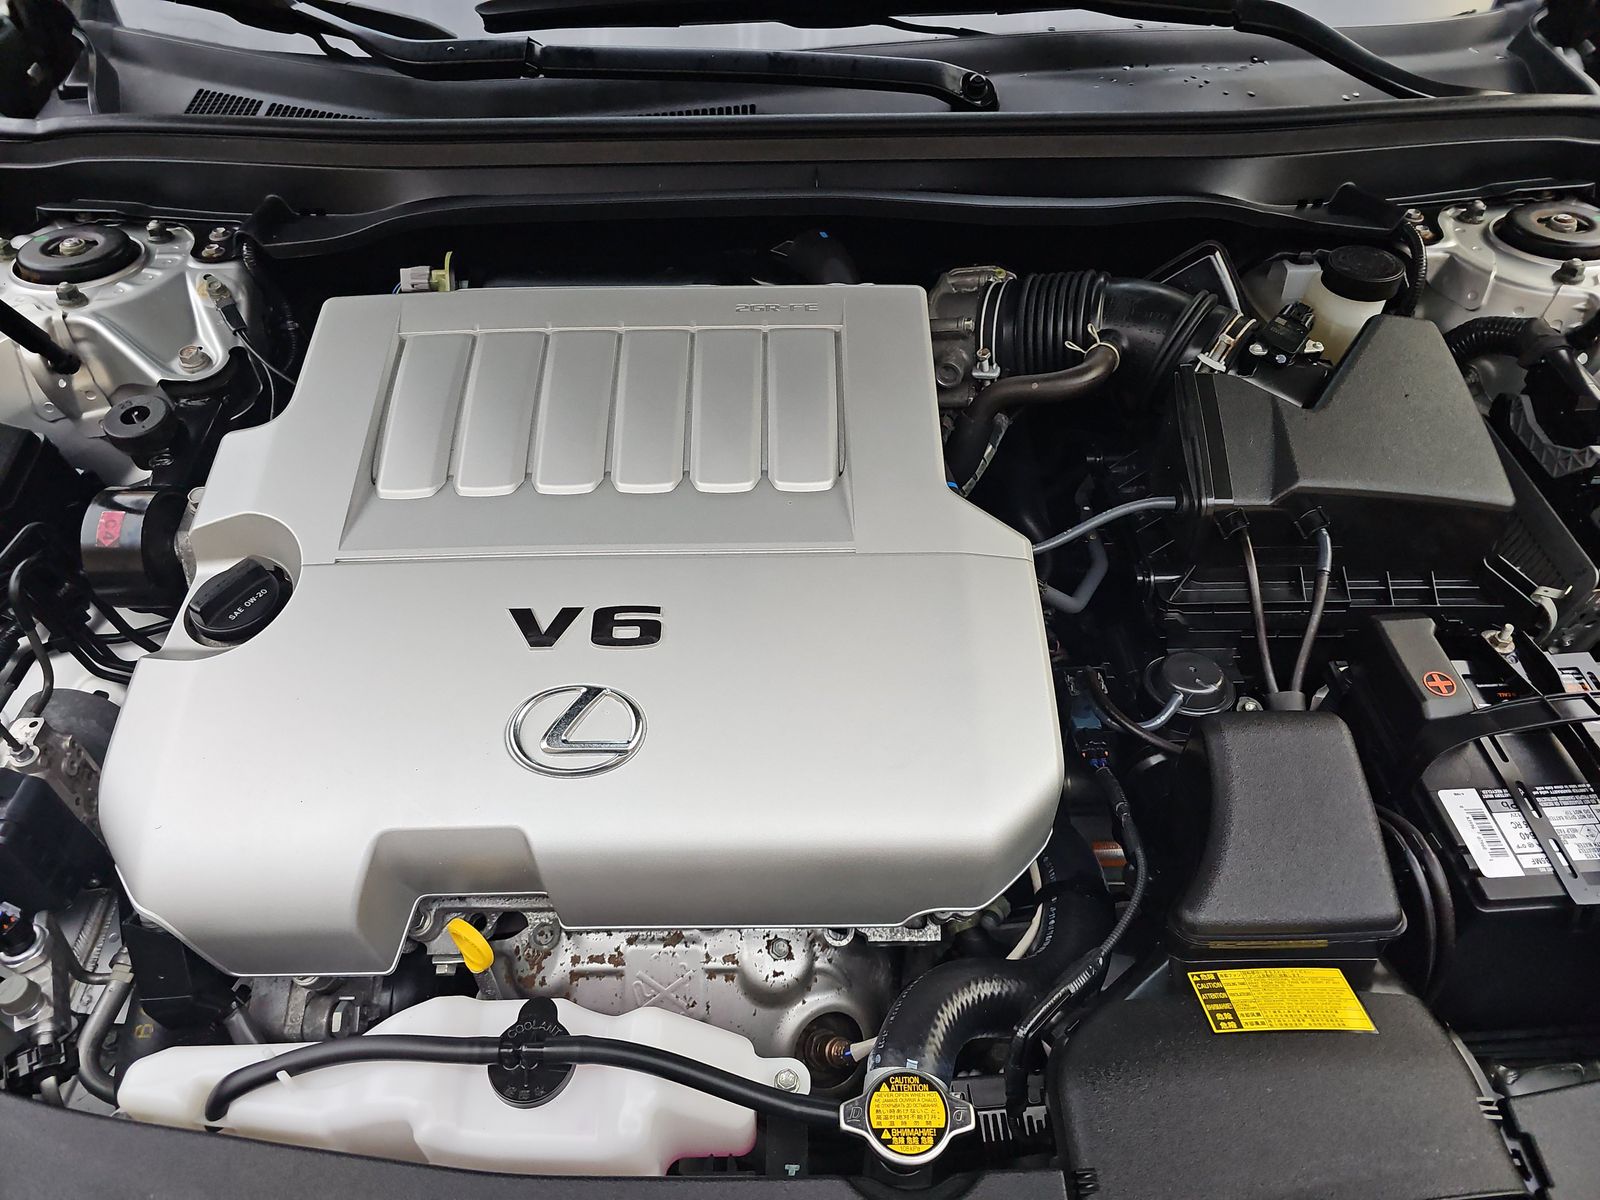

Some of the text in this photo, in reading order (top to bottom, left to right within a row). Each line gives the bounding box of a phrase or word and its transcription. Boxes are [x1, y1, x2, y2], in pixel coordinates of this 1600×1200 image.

[735, 303, 819, 313] 2GR-FE
[229, 589, 268, 620] SAE 0W-20
[508, 605, 662, 648] V6
[1510, 821, 1523, 829] RC
[1197, 981, 1223, 990] CAUTION
[1201, 992, 1229, 1000] ATTENTION
[507, 1019, 564, 1039] COOLANT
[889, 1076, 920, 1084] CAUTION
[890, 1084, 929, 1092] ATTENTION
